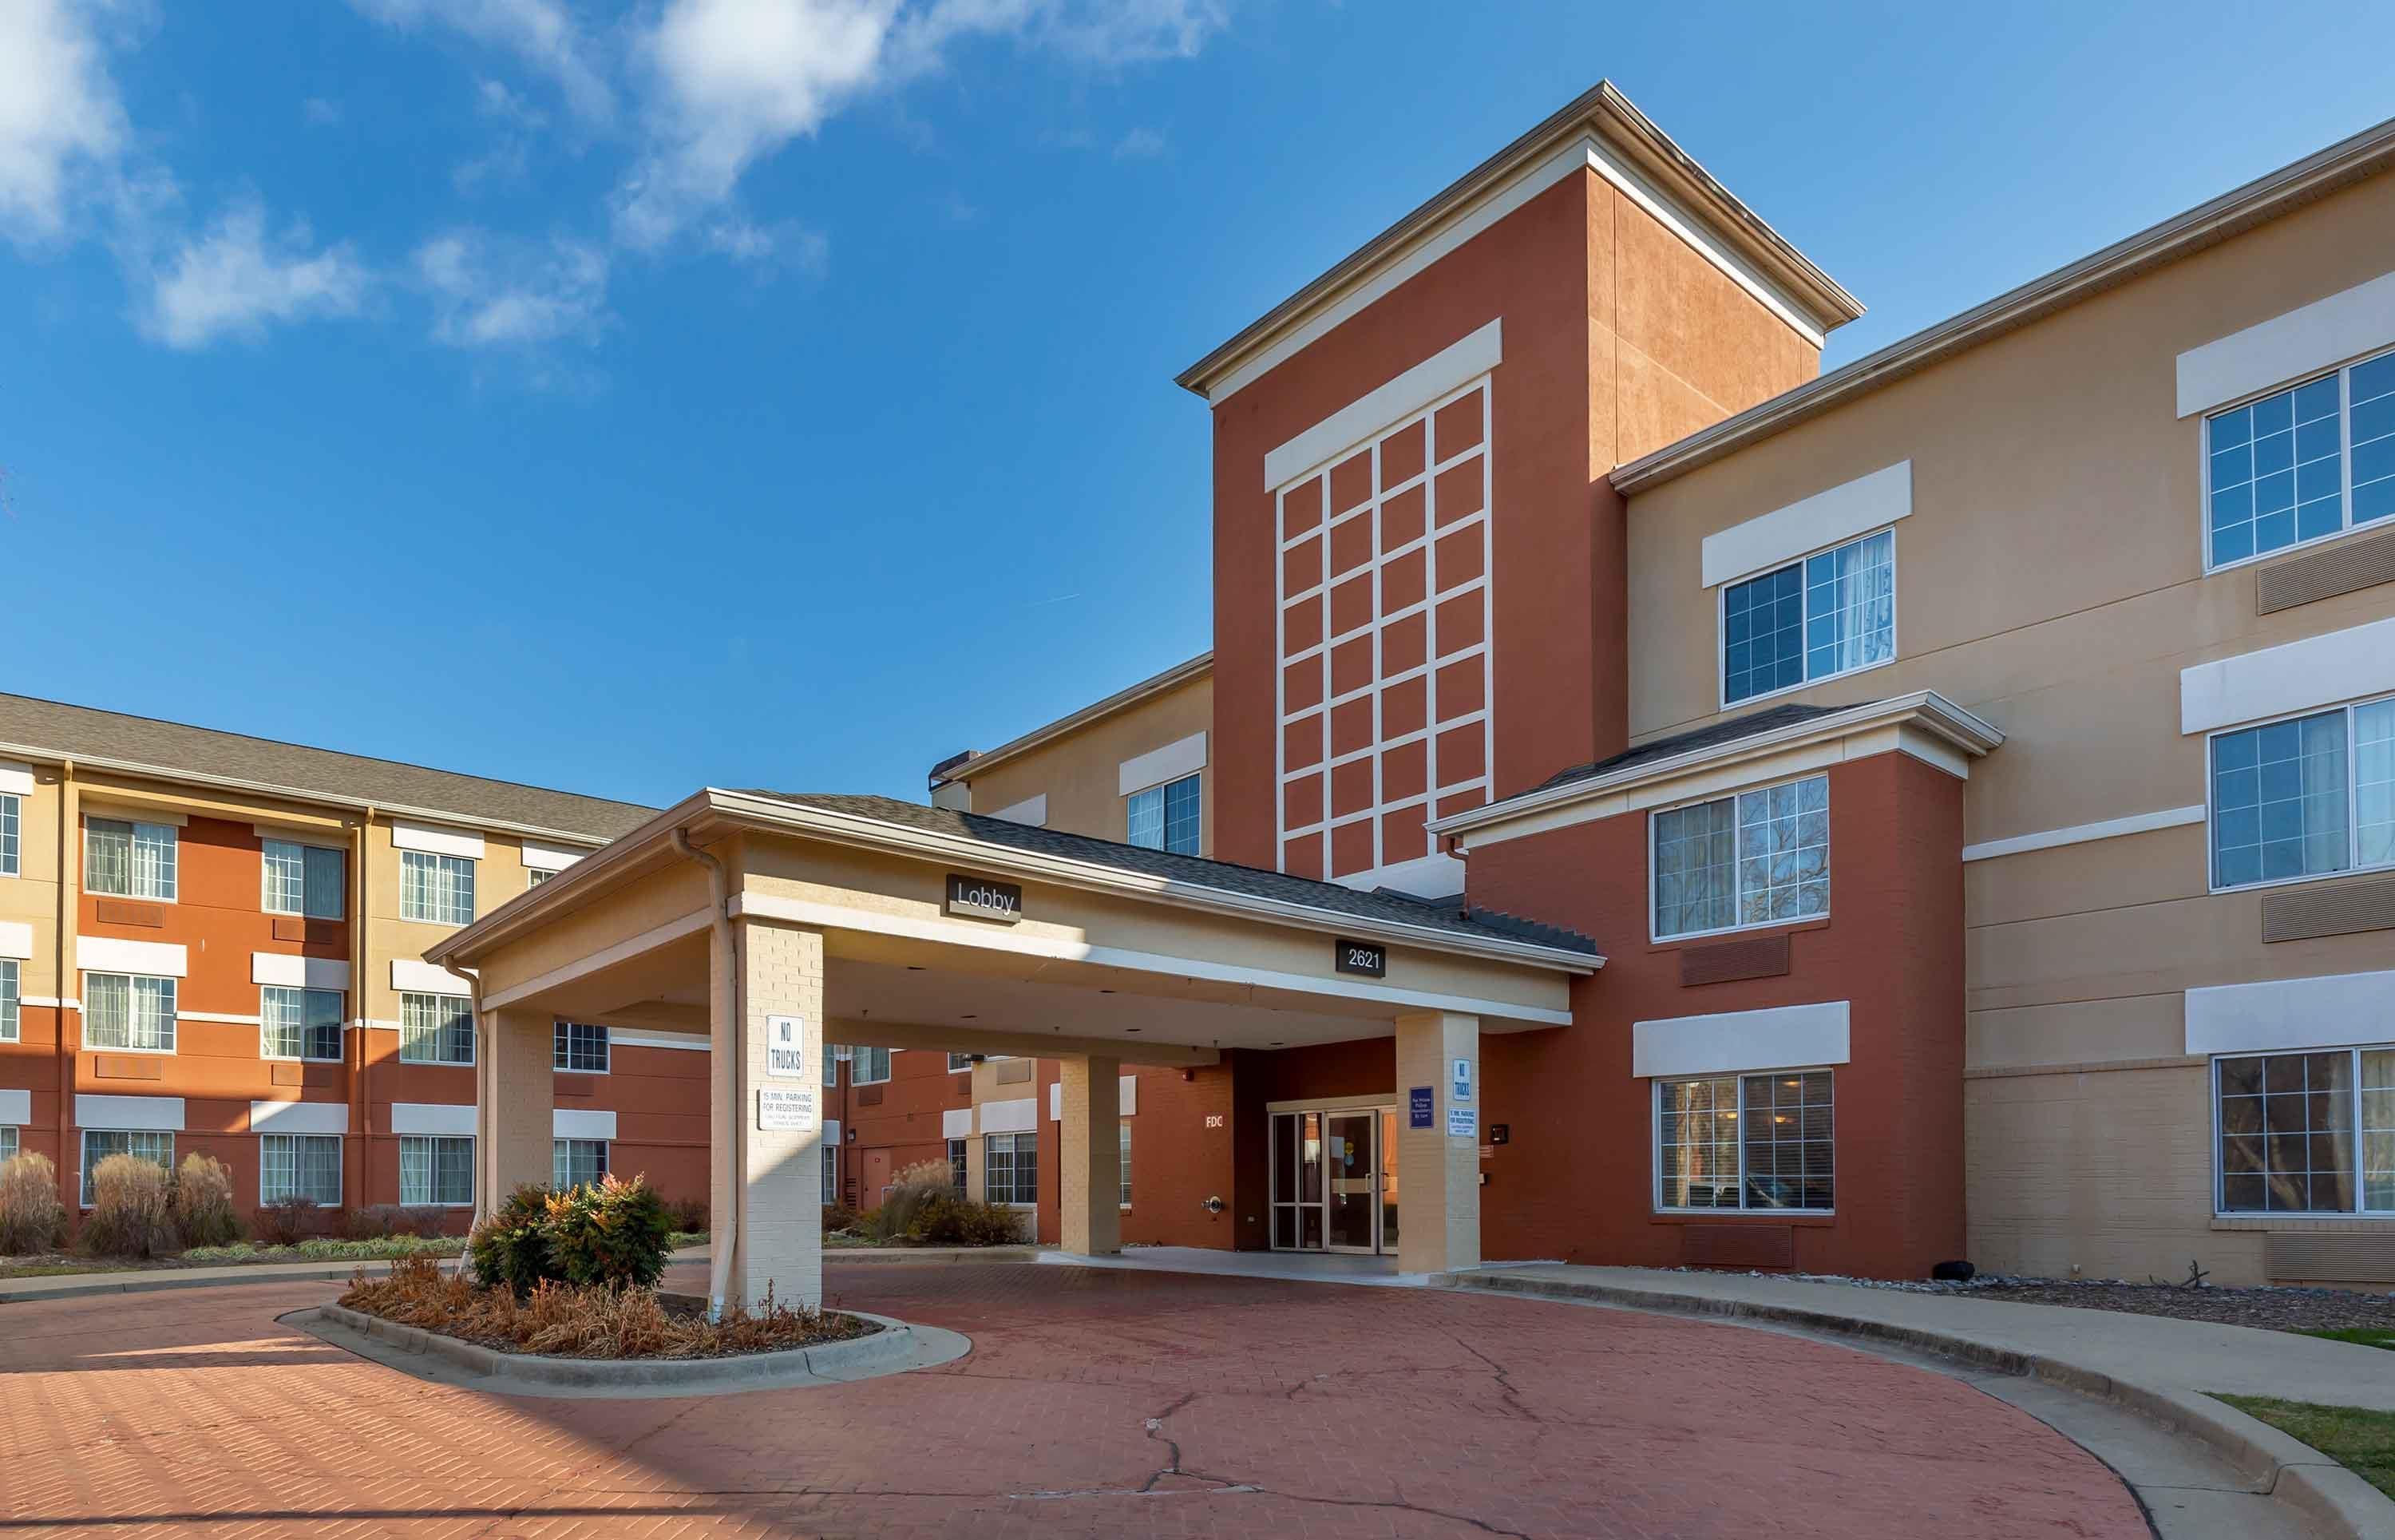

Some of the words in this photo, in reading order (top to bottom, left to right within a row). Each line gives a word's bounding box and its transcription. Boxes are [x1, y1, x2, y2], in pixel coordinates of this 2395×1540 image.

[958, 882, 1014, 916] Lobby
[1348, 948, 1379, 968] 2621
[781, 1021, 791, 1042] NO
[771, 1049, 801, 1071] TRUCKS
[763, 1103, 774, 1111] FOR
[775, 1103, 812, 1113] REGISTERING
[786, 1093, 812, 1103] PARKING
[1206, 1115, 1222, 1127] FDC
